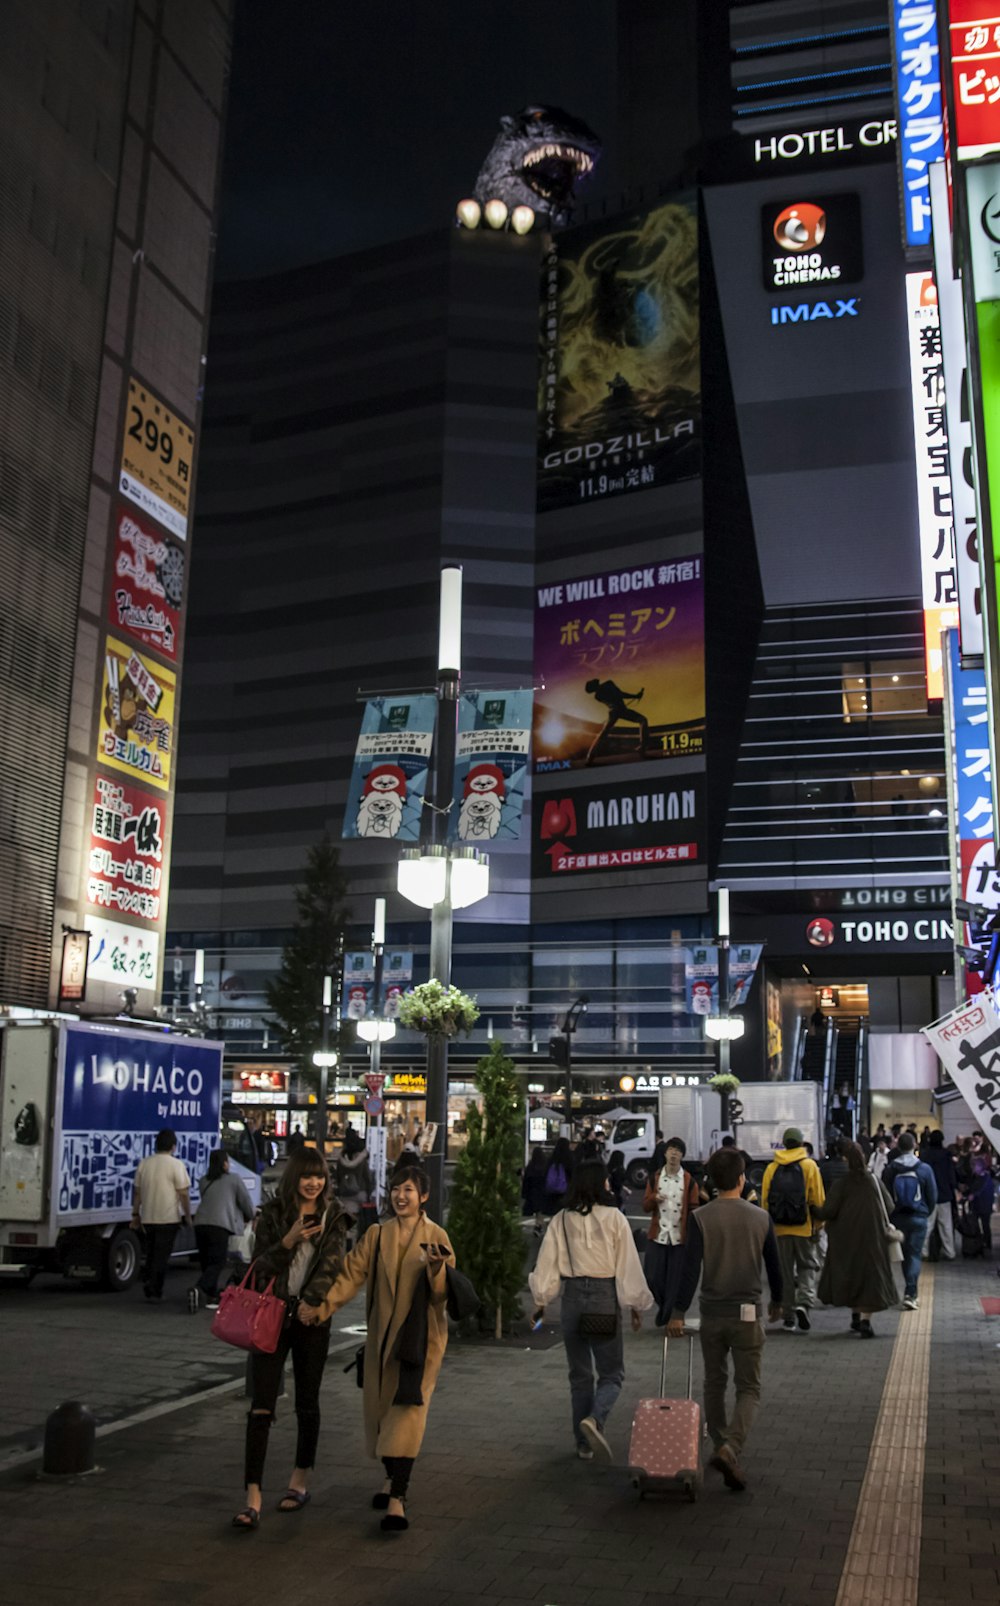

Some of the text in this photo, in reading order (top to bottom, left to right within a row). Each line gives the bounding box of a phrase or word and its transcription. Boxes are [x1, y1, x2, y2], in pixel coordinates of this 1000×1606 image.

[754, 127, 853, 162] HOTEL
[773, 253, 822, 273] TOHO
[773, 266, 841, 286] CINEMAS
[770, 299, 858, 325] IMAX
[128, 404, 174, 464] 299
[177, 459, 189, 483] 円
[543, 419, 694, 469] GODZILLA
[579, 475, 607, 498] 11.9
[538, 560, 701, 607] WE WILL ROCK 新宿!
[560, 606, 677, 645] ボヘミアン
[103, 731, 165, 778] ウェルカム
[660, 732, 689, 750] 11.9
[536, 760, 572, 773] IMAX
[586, 790, 697, 830] MARUHAN
[841, 921, 909, 942] TOHO
[91, 1054, 203, 1096] LOHACO
[157, 1099, 202, 1119] by ASKUL
